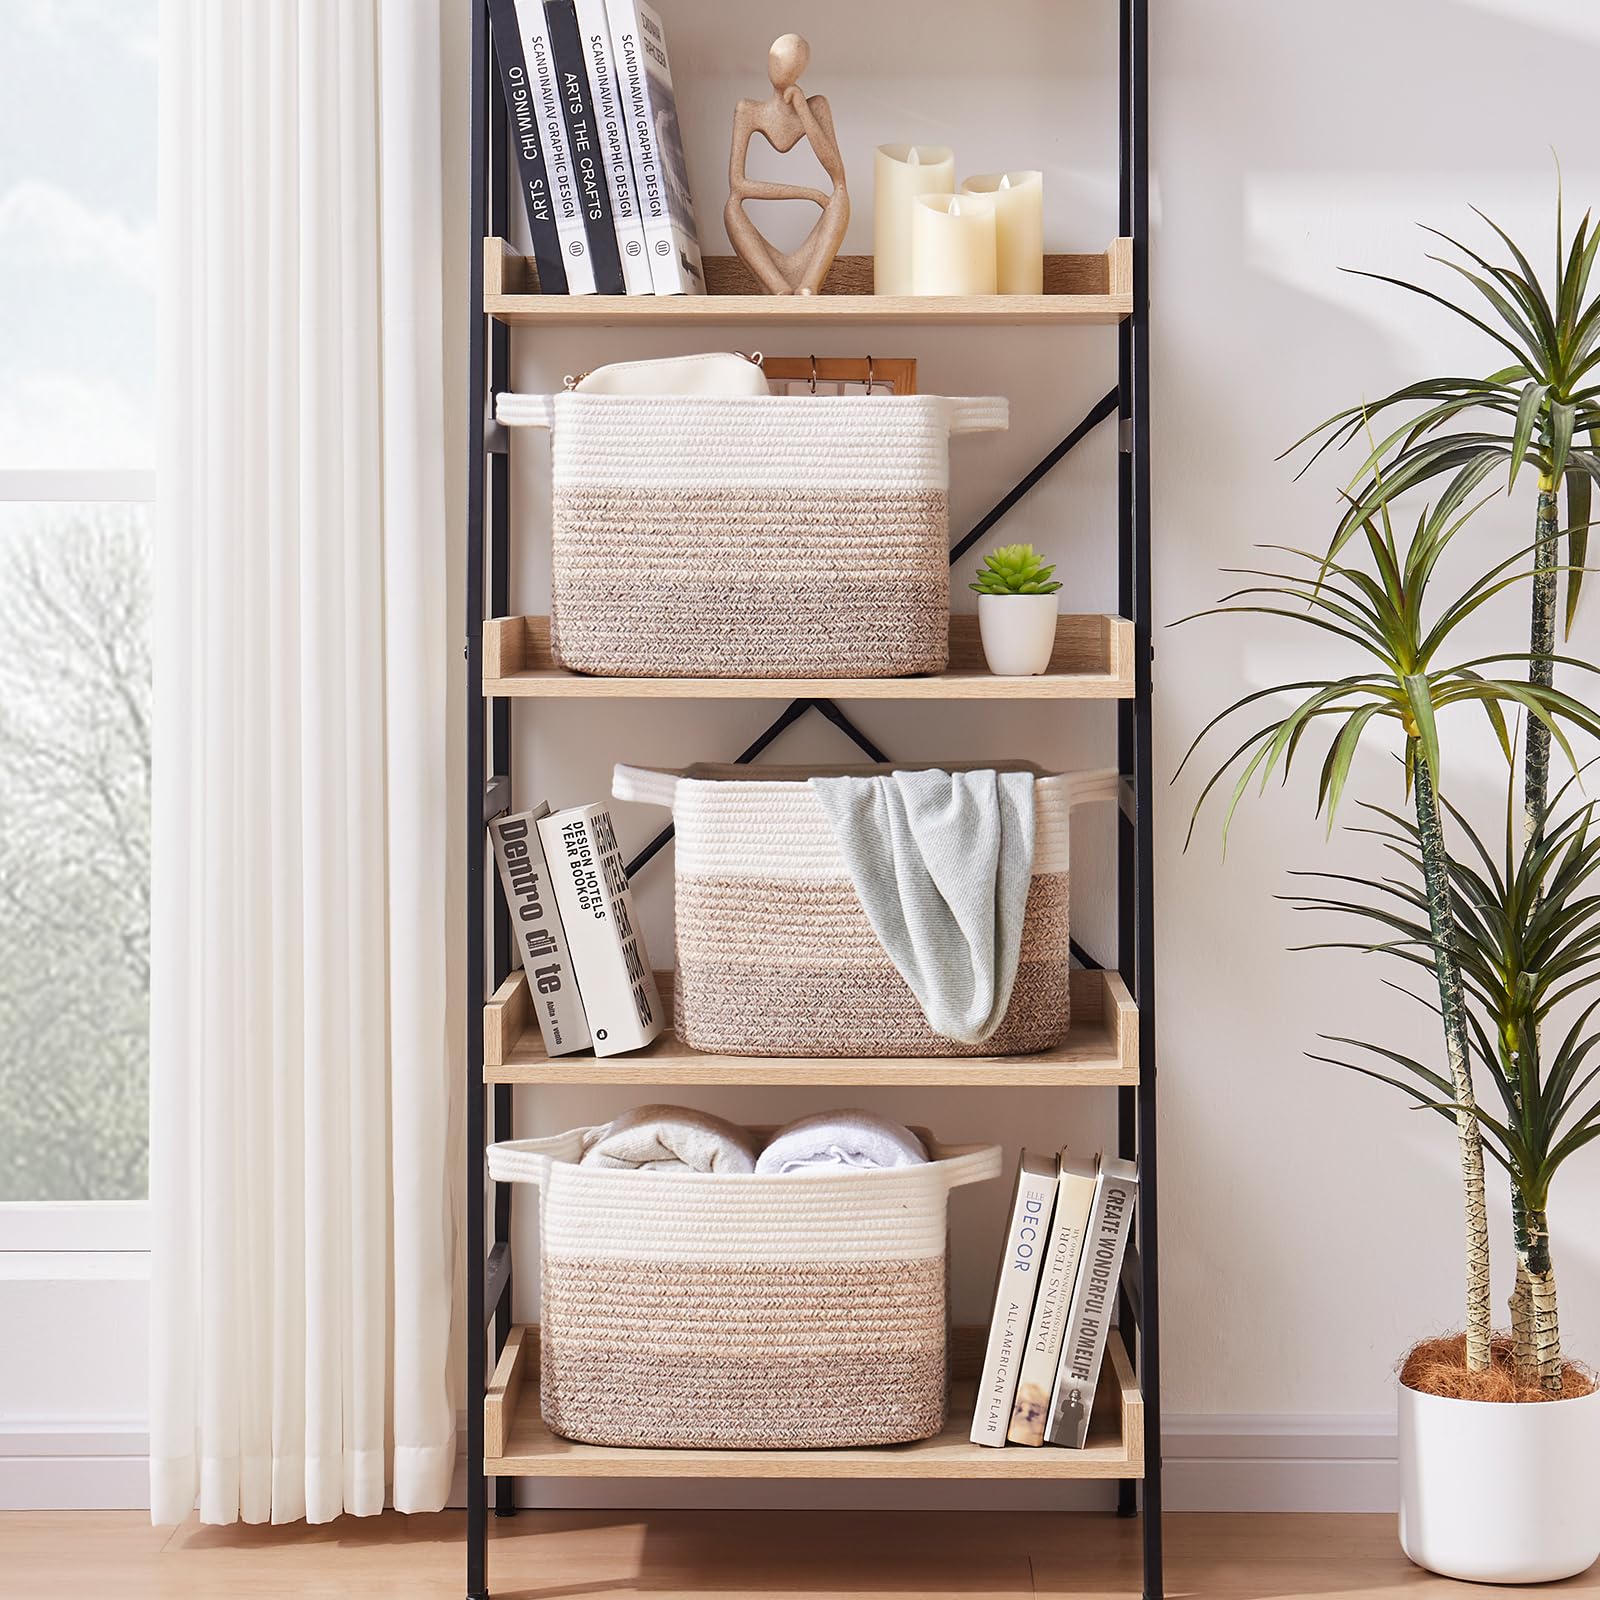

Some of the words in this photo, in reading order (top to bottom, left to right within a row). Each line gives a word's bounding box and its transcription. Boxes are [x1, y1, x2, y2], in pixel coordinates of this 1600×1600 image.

[564, 72, 583, 115] ARTS
[520, 133, 538, 160] CHI
[573, 119, 591, 153] THE
[606, 121, 626, 173] GRAPHIC
[548, 121, 567, 173] GRAPHIC
[558, 174, 575, 219] DESIGN
[580, 158, 602, 221] CRAFTS
[636, 120, 655, 173] GRAPHIC
[646, 174, 662, 218] DESIGN
[529, 179, 550, 221] ARTS
[615, 174, 633, 218] DESIGN
[561, 824, 577, 858] YEAR
[498, 818, 544, 922] Dentro
[573, 821, 594, 867] DESIGN
[585, 870, 606, 919] HOTELS
[525, 928, 558, 958] di
[534, 963, 562, 995] te
[1026, 1191, 1044, 1201] ELLE
[1101, 1188, 1126, 1235] CREATE
[1014, 1201, 1042, 1273] DECOR
[1035, 1278, 1060, 1353] DARWINS
[1052, 1226, 1071, 1274] TEORI
[1084, 1238, 1119, 1318] WONDERFUL
[993, 1302, 1019, 1393] ALL-AMERICAN
[1070, 1318, 1100, 1382] HOMELIFE
[986, 1399, 1001, 1433] FLAIR
